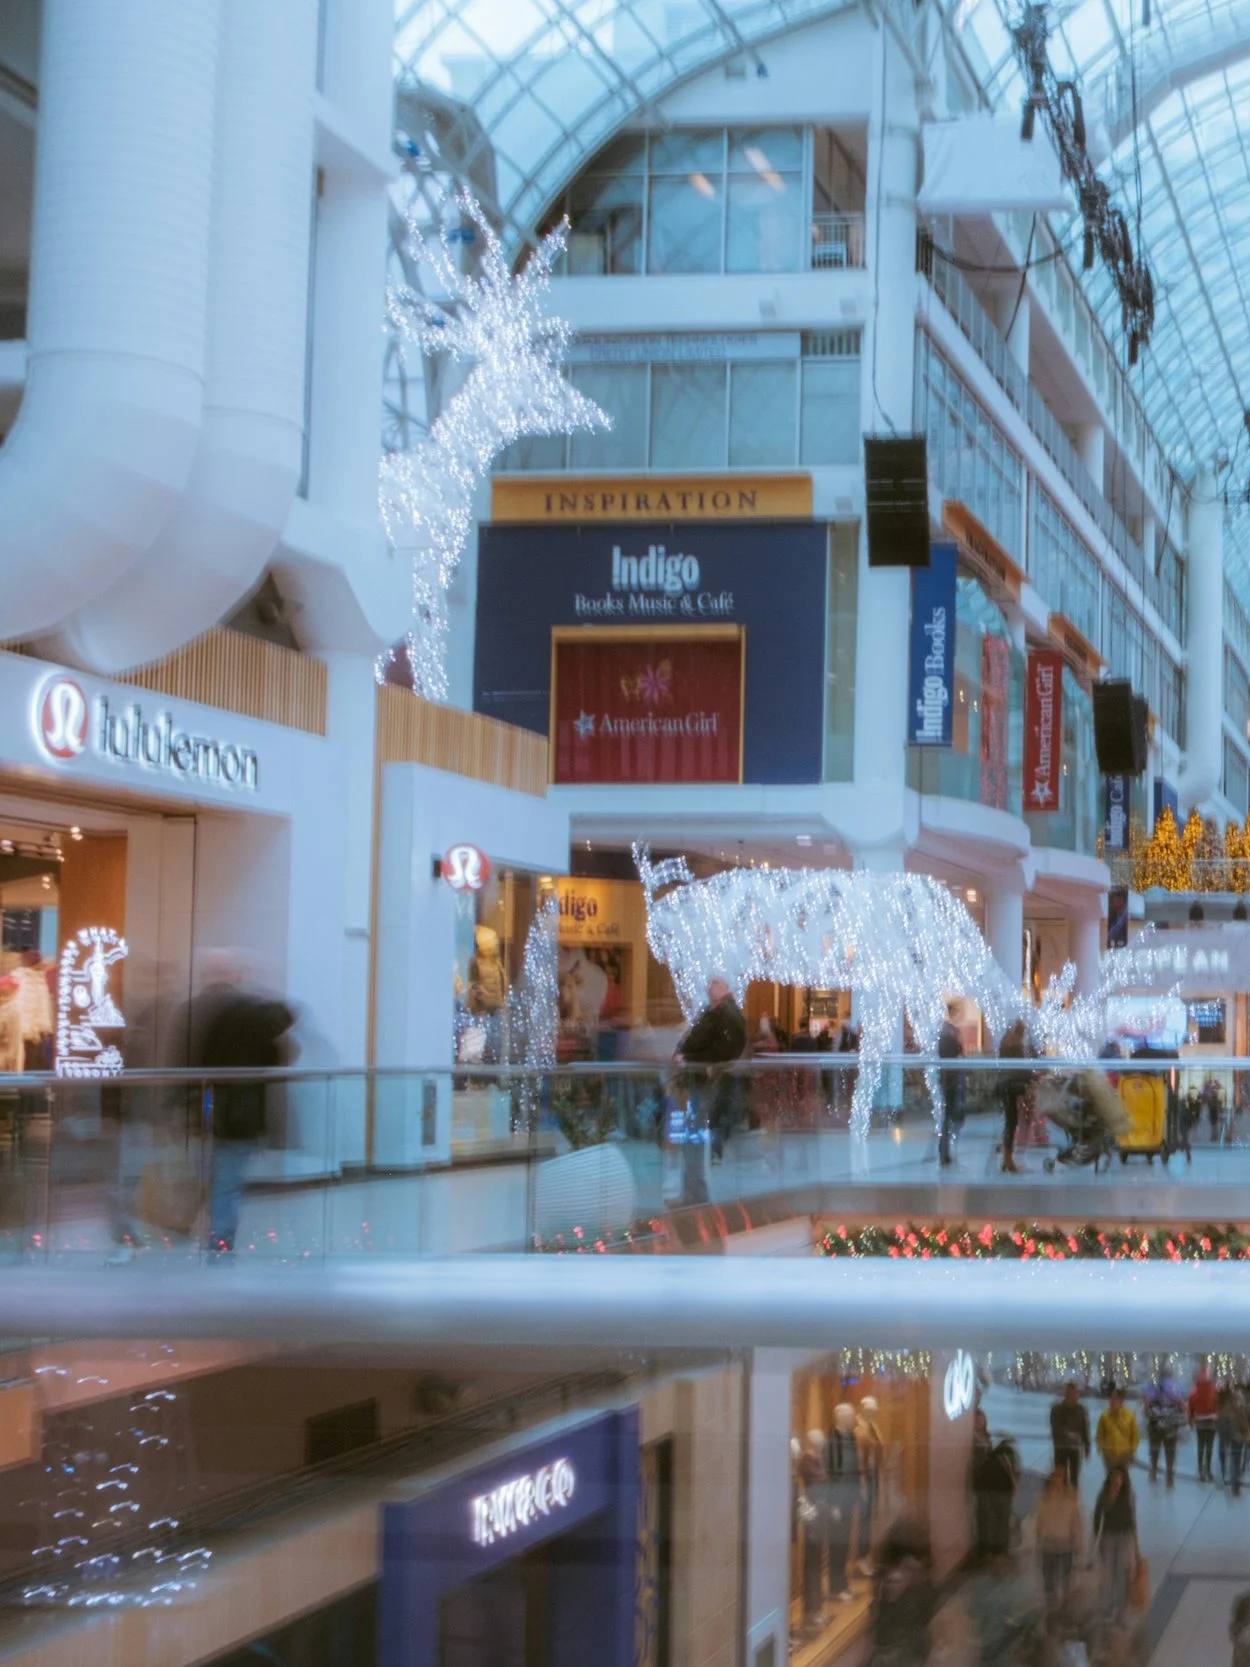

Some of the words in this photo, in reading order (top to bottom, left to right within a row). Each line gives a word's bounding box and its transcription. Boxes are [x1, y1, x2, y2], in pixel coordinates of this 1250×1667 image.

[544, 490, 759, 514] INSPIRATION
[611, 544, 700, 595] Indigo
[574, 592, 625, 613] Books
[628, 592, 677, 613] Music
[680, 593, 696, 613] &
[697, 591, 735, 613] Café
[924, 606, 946, 676] Books
[599, 713, 685, 733] American
[686, 711, 720, 733] Girl
[915, 675, 949, 743] Indigo
[1034, 699, 1054, 777] American
[94, 695, 259, 789] lululemon
